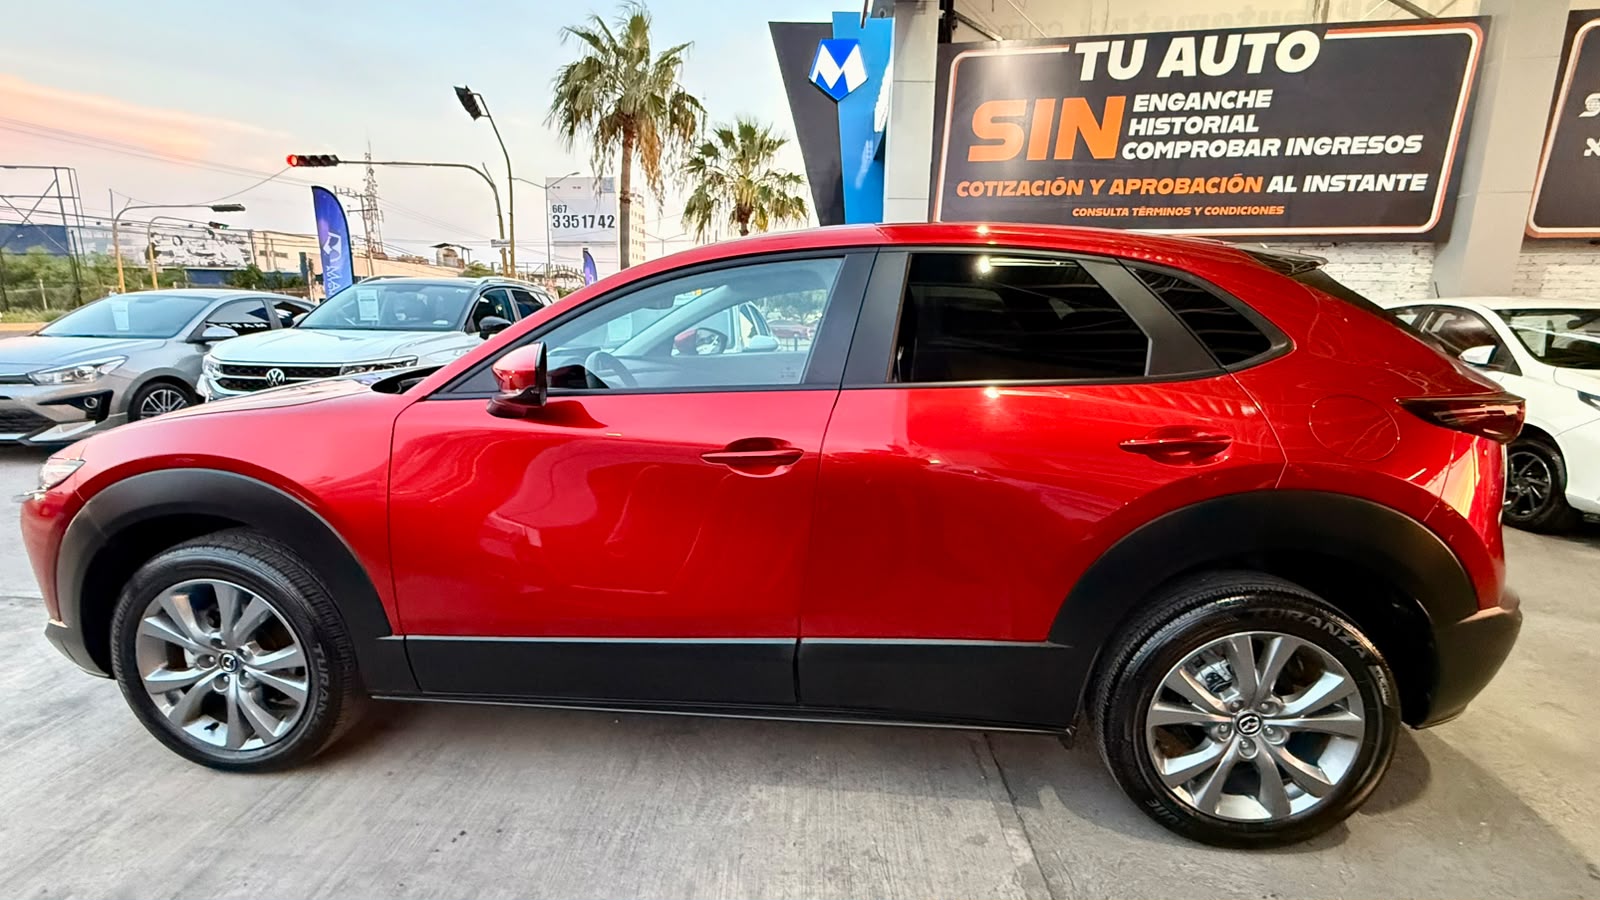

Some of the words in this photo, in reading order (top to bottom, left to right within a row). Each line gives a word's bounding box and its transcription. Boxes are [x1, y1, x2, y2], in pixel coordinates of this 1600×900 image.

[1074, 39, 1147, 81] TU
[1157, 30, 1320, 78] AUTO
[1132, 89, 1273, 113] ENGANCHE
[968, 95, 1126, 162] SIN
[1128, 114, 1259, 136] HISTORIAL
[1121, 138, 1281, 160] COMPROBAR
[1285, 135, 1423, 156] INGRESOS
[956, 177, 1083, 197] COTIZACIÓN
[1090, 179, 1106, 195] Y
[1109, 173, 1263, 195] APROBACIÓN
[1266, 175, 1297, 193] AL
[1302, 173, 1428, 193] INSTANTE
[552, 205, 568, 213] 667
[1072, 207, 1129, 217] CONSULTA
[1132, 205, 1192, 216] TÉRMINOS
[1194, 207, 1203, 216] Y
[1204, 205, 1285, 216] CONDICIONES
[552, 215, 616, 228] 3351742
